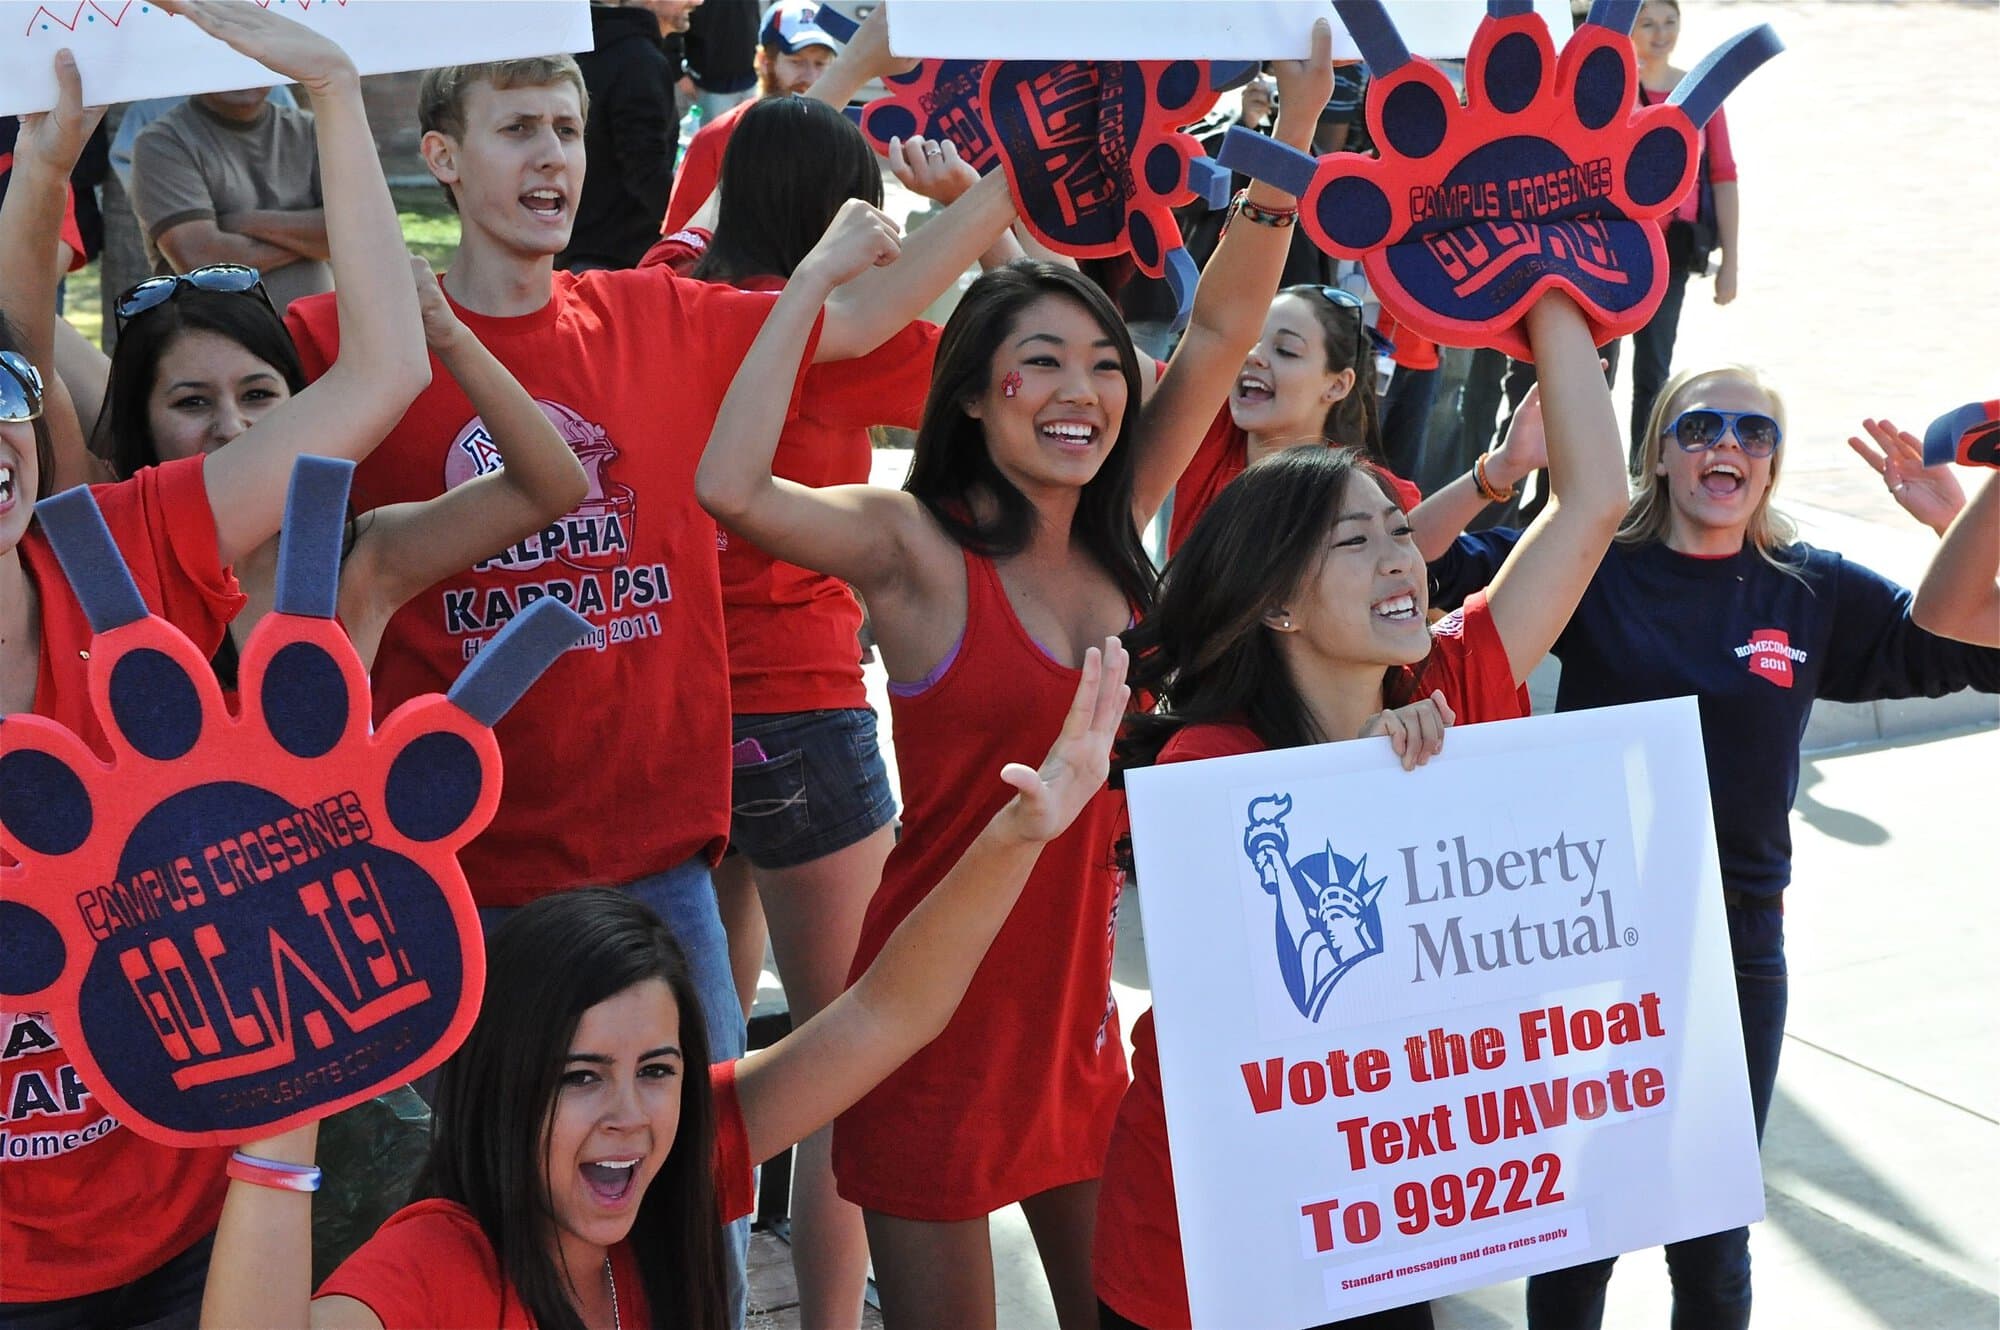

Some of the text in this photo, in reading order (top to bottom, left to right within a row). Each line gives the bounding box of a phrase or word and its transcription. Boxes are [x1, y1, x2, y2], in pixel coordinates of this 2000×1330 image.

[1409, 156, 1613, 224] CAMPUS CROSSINGS
[612, 566, 670, 609] PSI
[611, 614, 660, 641] 2011
[1734, 640, 1807, 663] HOMECOMING
[1760, 657, 1787, 672] 2011
[76, 790, 373, 941] CAMPUS CROSSINGS
[1398, 831, 1607, 907] Liberty
[119, 936, 222, 1061] GO
[1240, 992, 1666, 1114] Vote the Float
[1337, 1067, 1666, 1171] Text UAVote
[1301, 1153, 1565, 1253] To 99222
[1341, 1228, 1568, 1290] Standard messaging and data rates apply
